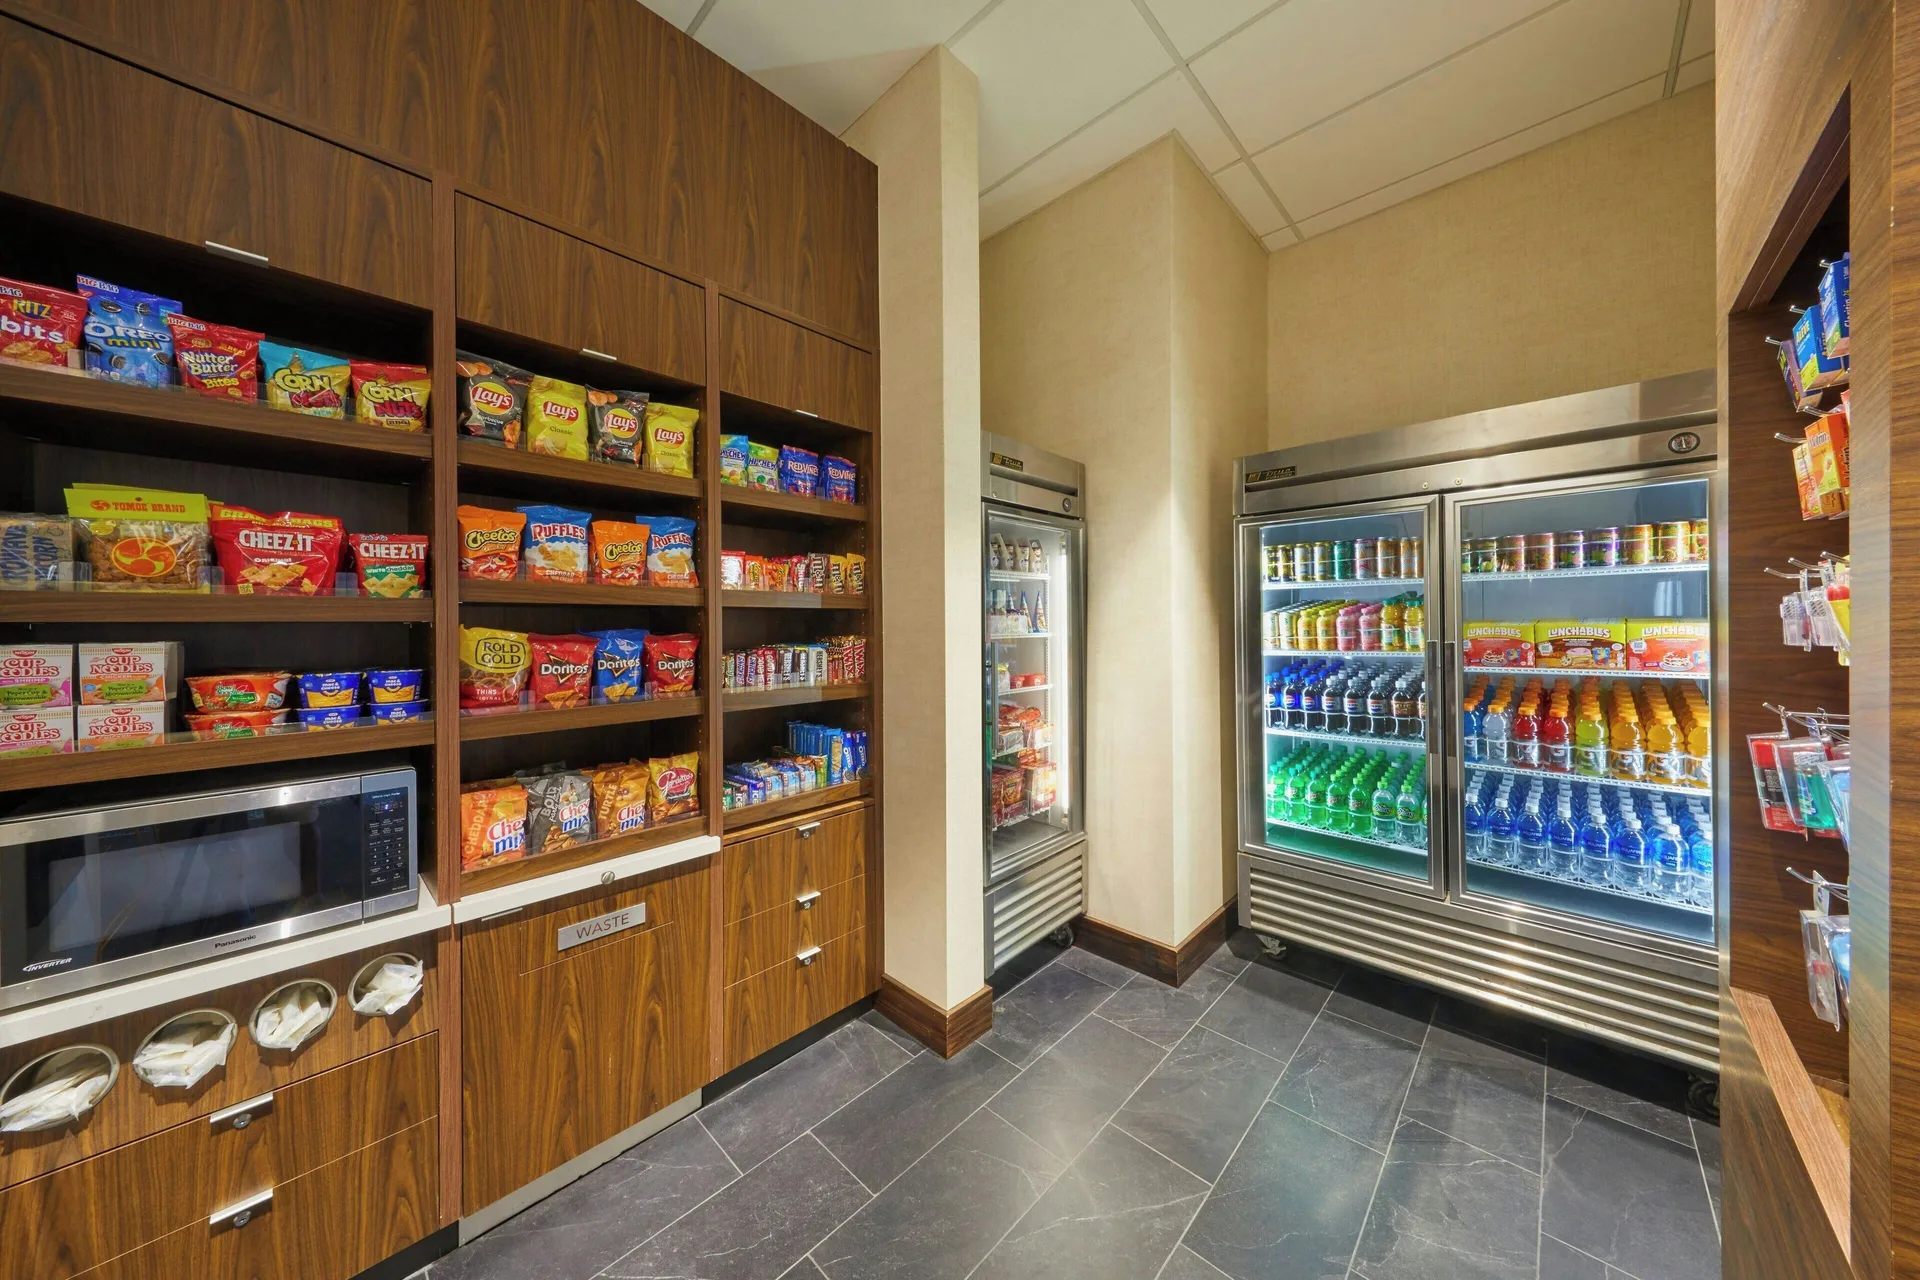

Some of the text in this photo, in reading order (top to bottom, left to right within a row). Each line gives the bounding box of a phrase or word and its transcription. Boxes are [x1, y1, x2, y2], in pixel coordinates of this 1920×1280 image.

[13, 299, 52, 318] RITZ
[0, 315, 65, 344] bits
[84, 322, 171, 342] OREO
[105, 338, 162, 350] mini
[180, 351, 234, 365] Nutter
[189, 362, 239, 376] Butter
[202, 377, 240, 389] Bites
[273, 368, 332, 392] CORN
[360, 380, 415, 403] CORN
[473, 387, 511, 407] Lay's
[545, 401, 577, 419] Lay's
[607, 414, 636, 431] Lay's
[656, 428, 684, 443] Lay's
[112, 502, 186, 513] TOMOE BRAND
[466, 528, 517, 549] Cheetos
[531, 523, 586, 541] RUFFLES
[652, 532, 693, 549] RUFFLES
[604, 540, 643, 561] Cheetos
[1467, 627, 1522, 638] LUNCHABLES
[1548, 626, 1611, 638] LUNCHABLES
[483, 642, 520, 654] ROLD
[4, 658, 46, 668] CUP
[104, 656, 141, 665] CUP
[481, 653, 521, 664] GOLD
[597, 658, 640, 670] Doritos
[658, 659, 694, 670] Doritos
[90, 662, 153, 674] NOODLES
[541, 663, 589, 675] Doritos
[104, 715, 141, 725] CUP
[4, 722, 46, 733] CUP
[89, 722, 153, 735] NOODLES
[598, 784, 618, 820] TURTLE
[560, 799, 590, 821] Chex
[562, 815, 590, 833] mix
[576, 913, 629, 939] WASTE
[214, 934, 257, 948] Panasonic
[26, 957, 72, 972] INVERTER
